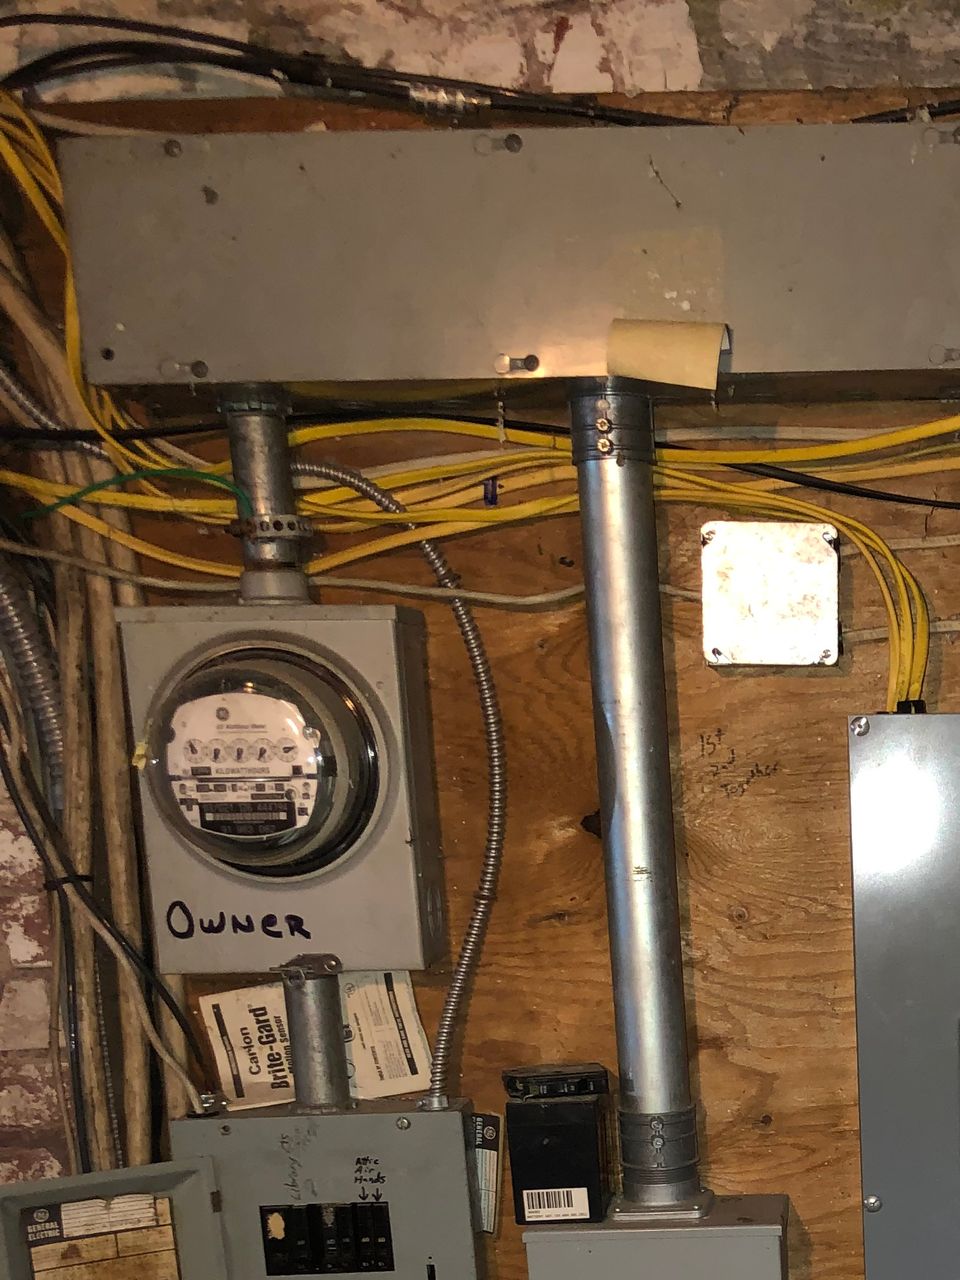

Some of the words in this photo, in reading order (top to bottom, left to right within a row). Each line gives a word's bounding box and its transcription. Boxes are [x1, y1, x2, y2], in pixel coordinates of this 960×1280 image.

[273, 1015, 289, 1043] Sensor
[240, 1027, 261, 1075] Carlon
[248, 1006, 290, 1089] Brite-Gard
[27, 1221, 60, 1233] GENERAL
[28, 1229, 61, 1241] ELECTRIC
